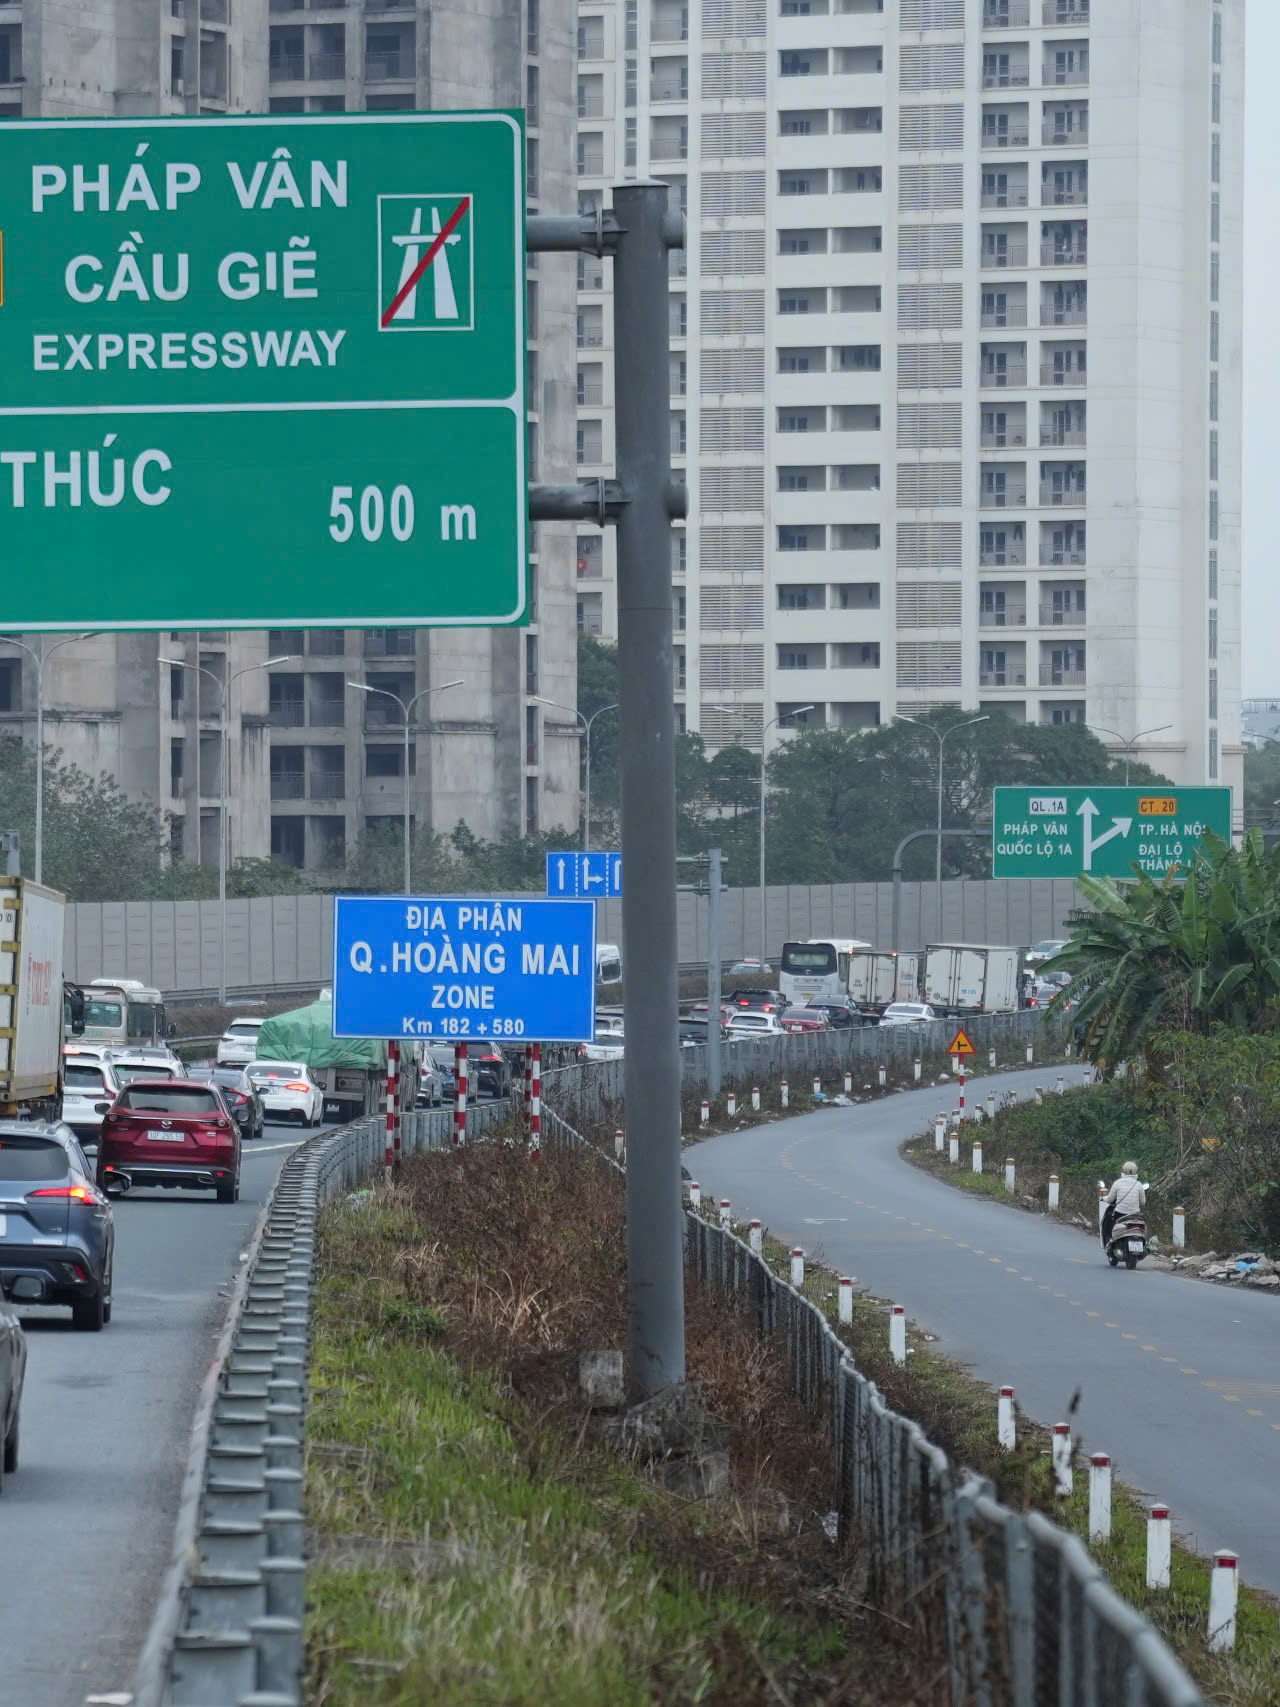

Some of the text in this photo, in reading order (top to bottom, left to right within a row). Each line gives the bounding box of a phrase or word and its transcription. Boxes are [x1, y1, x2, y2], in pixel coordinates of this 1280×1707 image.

[32, 143, 348, 213] PHÁP VÂN
[64, 231, 318, 303] CẦU GIẼ
[33, 330, 346, 371] EXPRESSWAY
[0, 434, 172, 507] THÚC
[328, 485, 477, 543] 500 m
[1031, 801, 1064, 812] QL.1A
[1140, 801, 1174, 812] CT.20
[1004, 820, 1068, 836] PHÁP VÂN
[997, 839, 1072, 858] QUỐC LỘ 1A
[1139, 841, 1183, 858] ĐẠI LỘ
[406, 903, 522, 937] ĐỊA PHẬN
[522, 944, 579, 976] MAI
[431, 985, 495, 1010] ZONE
[403, 1017, 433, 1034] Km
[440, 1018, 470, 1035] 182
